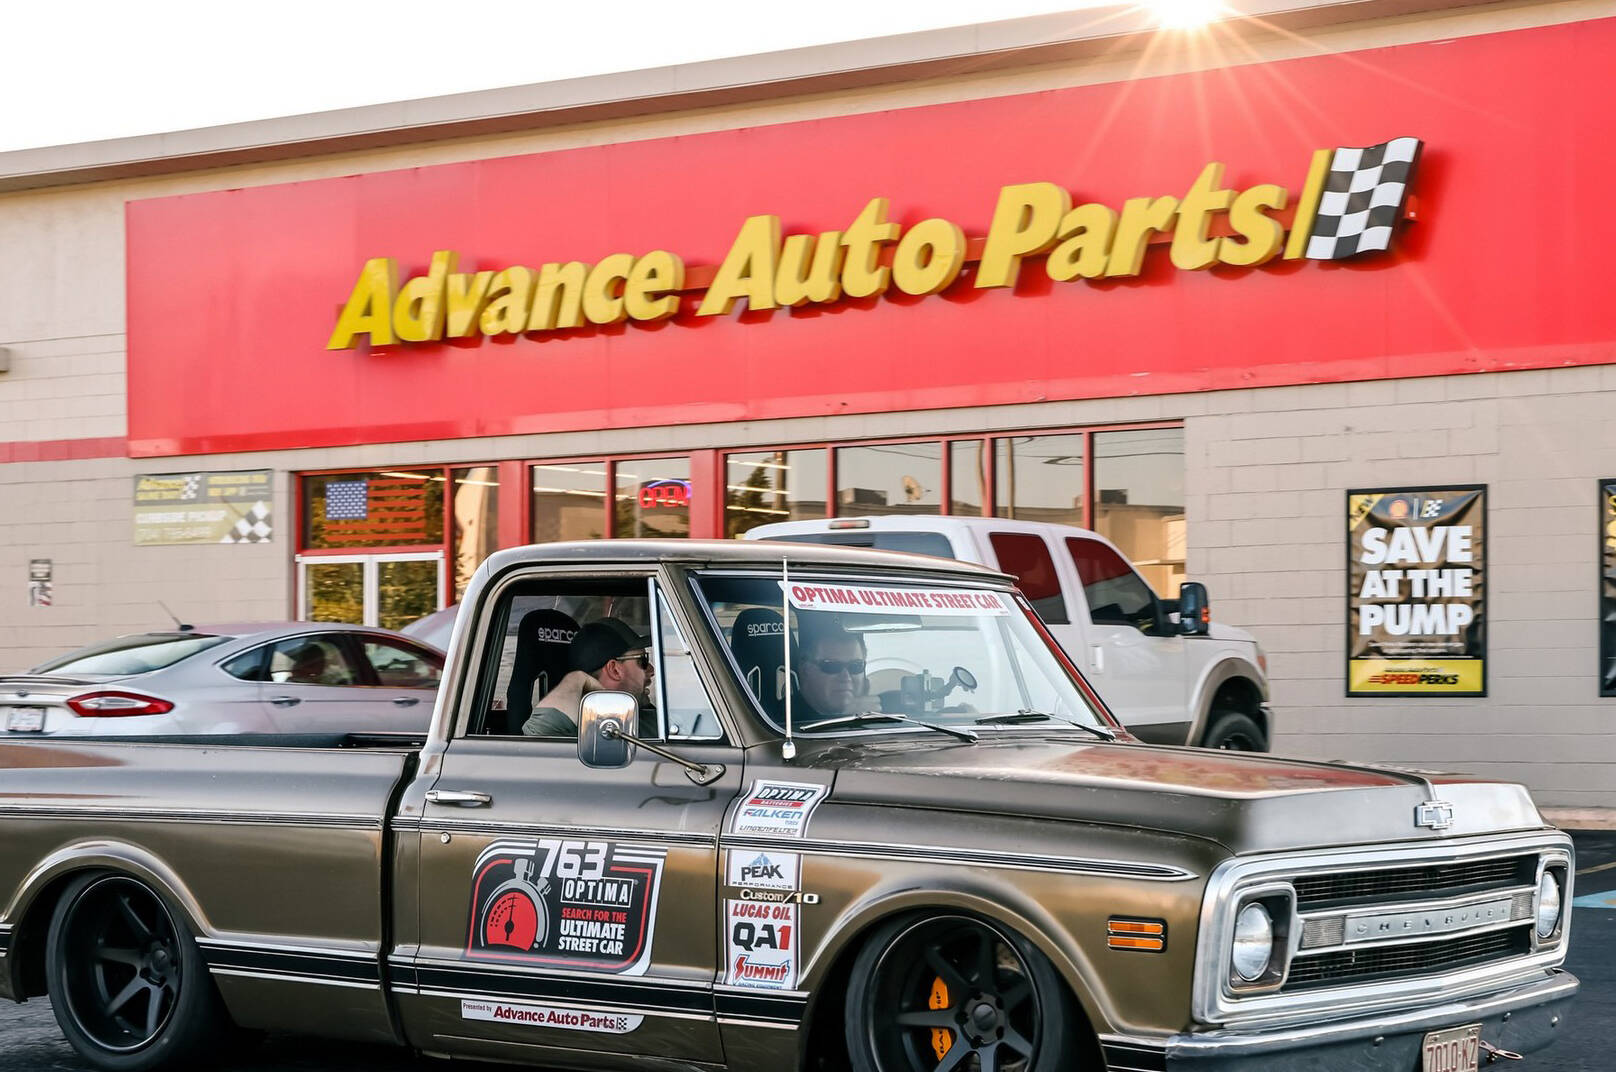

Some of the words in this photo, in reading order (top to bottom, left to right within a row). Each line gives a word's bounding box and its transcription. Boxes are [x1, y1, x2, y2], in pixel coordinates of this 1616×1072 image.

[327, 250, 685, 350] Advance
[695, 197, 966, 316] Auto
[974, 162, 1286, 288] Parts
[639, 485, 688, 508] OPEN
[1360, 525, 1473, 565] SAVE
[1360, 570, 1404, 598] AT
[1406, 568, 1473, 597] THE
[792, 585, 861, 605] OPTIMA
[858, 590, 933, 608] ULTIMATE
[929, 593, 978, 609] STREET
[974, 593, 1003, 610] CAR
[1359, 603, 1474, 635] PUMP
[759, 786, 815, 800] OPTIMA
[743, 808, 804, 820] FALKEN
[538, 839, 608, 880] 763
[741, 864, 784, 881] PEAK
[564, 879, 629, 903] OPTIMA
[562, 907, 592, 920] SEARCH
[594, 909, 610, 922] FOR
[612, 911, 627, 923] THE
[732, 903, 771, 919] LUCAS
[772, 906, 791, 920] OIL
[560, 919, 625, 940] ULTIMATE
[732, 922, 792, 952] QA1
[558, 936, 599, 953] STREET
[600, 940, 623, 955] CAR
[494, 1006, 545, 1023] Advance
[546, 1010, 579, 1026] Auto
[580, 1013, 615, 1029] Parts
